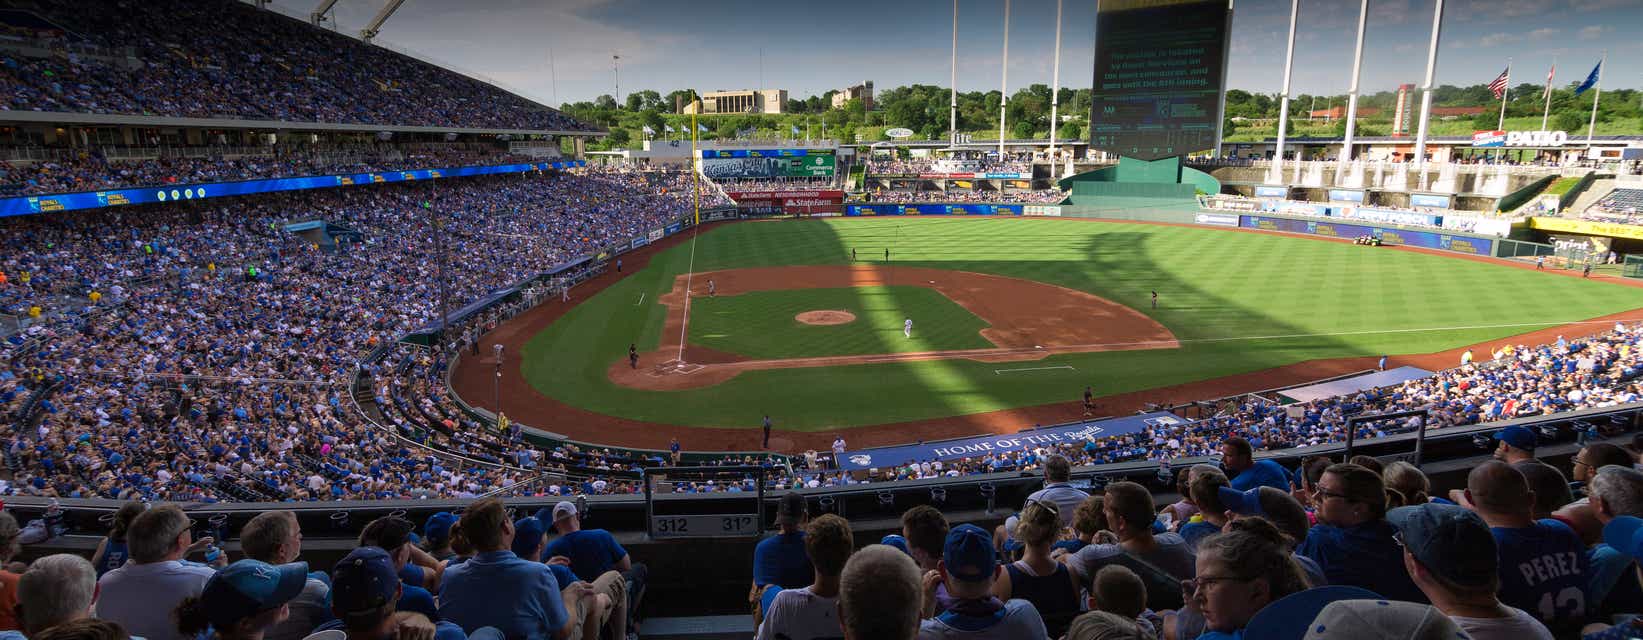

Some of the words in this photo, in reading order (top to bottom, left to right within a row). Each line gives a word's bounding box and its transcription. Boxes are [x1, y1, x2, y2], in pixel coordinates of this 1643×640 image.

[1506, 130, 1568, 147] PATIO
[1548, 236, 1590, 253] Sprint
[933, 441, 990, 458] HOME
[996, 437, 1022, 449] OF
[1023, 432, 1061, 447] THE
[657, 518, 688, 532] 312
[1519, 551, 1583, 587] PEREZ
